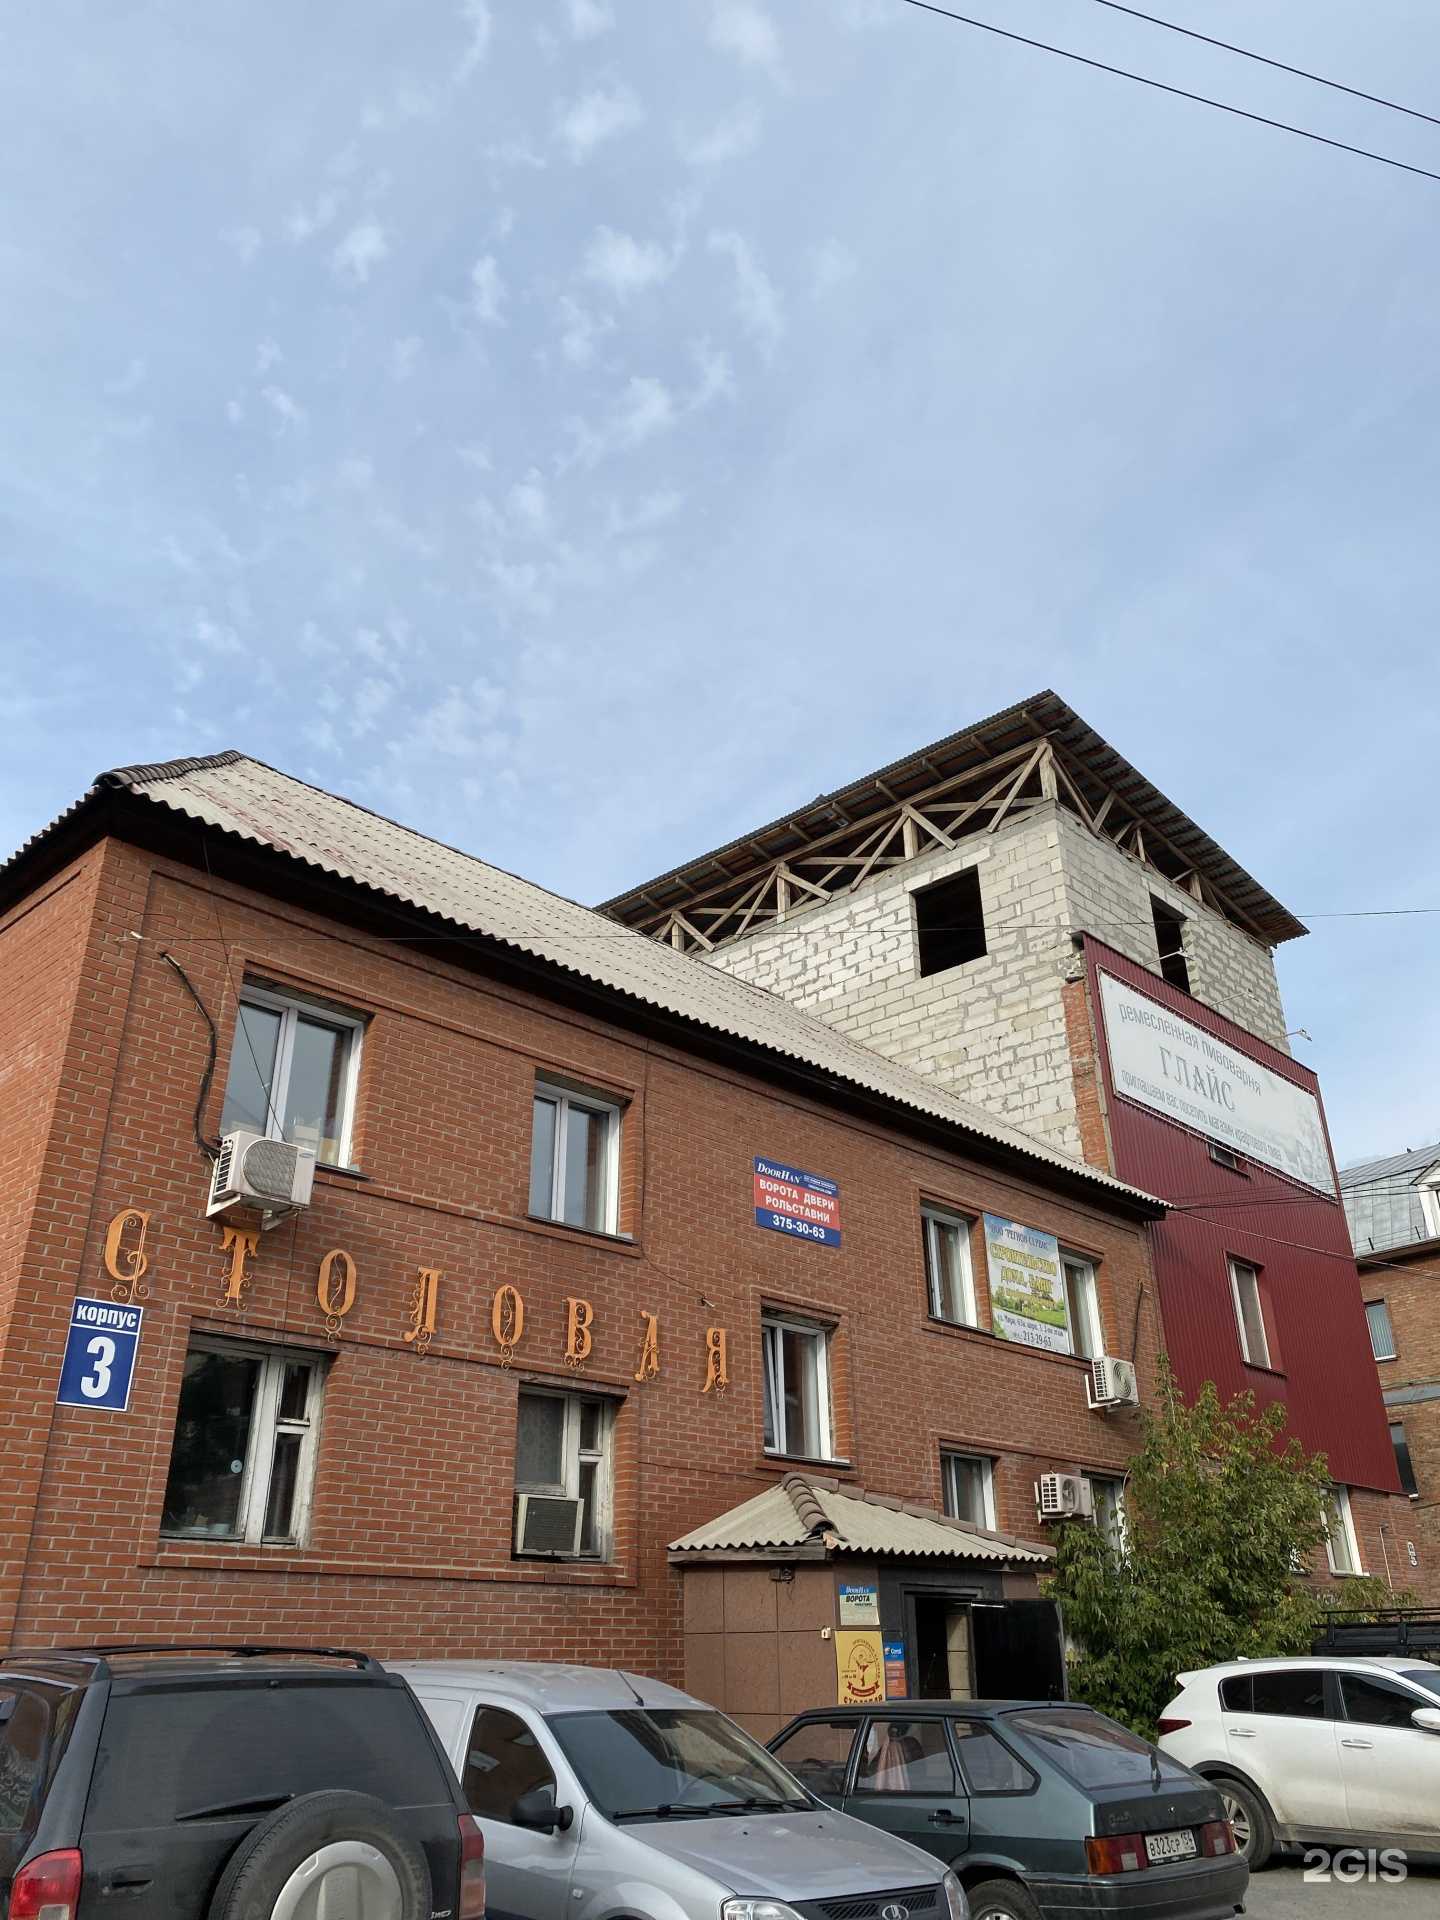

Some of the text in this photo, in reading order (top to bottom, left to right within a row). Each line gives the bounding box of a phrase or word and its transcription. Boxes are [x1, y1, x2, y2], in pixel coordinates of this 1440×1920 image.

[1118, 1003, 1262, 1096] ремесленная пивоварня
[1159, 1046, 1235, 1112] ГЛАЙС
[759, 1179, 799, 1199] ВОРОТА
[804, 1193, 834, 1211] ДВЕРИ
[765, 1195, 830, 1223] РОЛЬСТАВНИ
[773, 1214, 825, 1239] 375-30-63
[76, 1304, 137, 1329] корпус
[104, 1207, 729, 1397] СТОЛОВАЯ
[80, 1336, 116, 1399] 3
[845, 1594, 870, 1603] ВОРОТА
